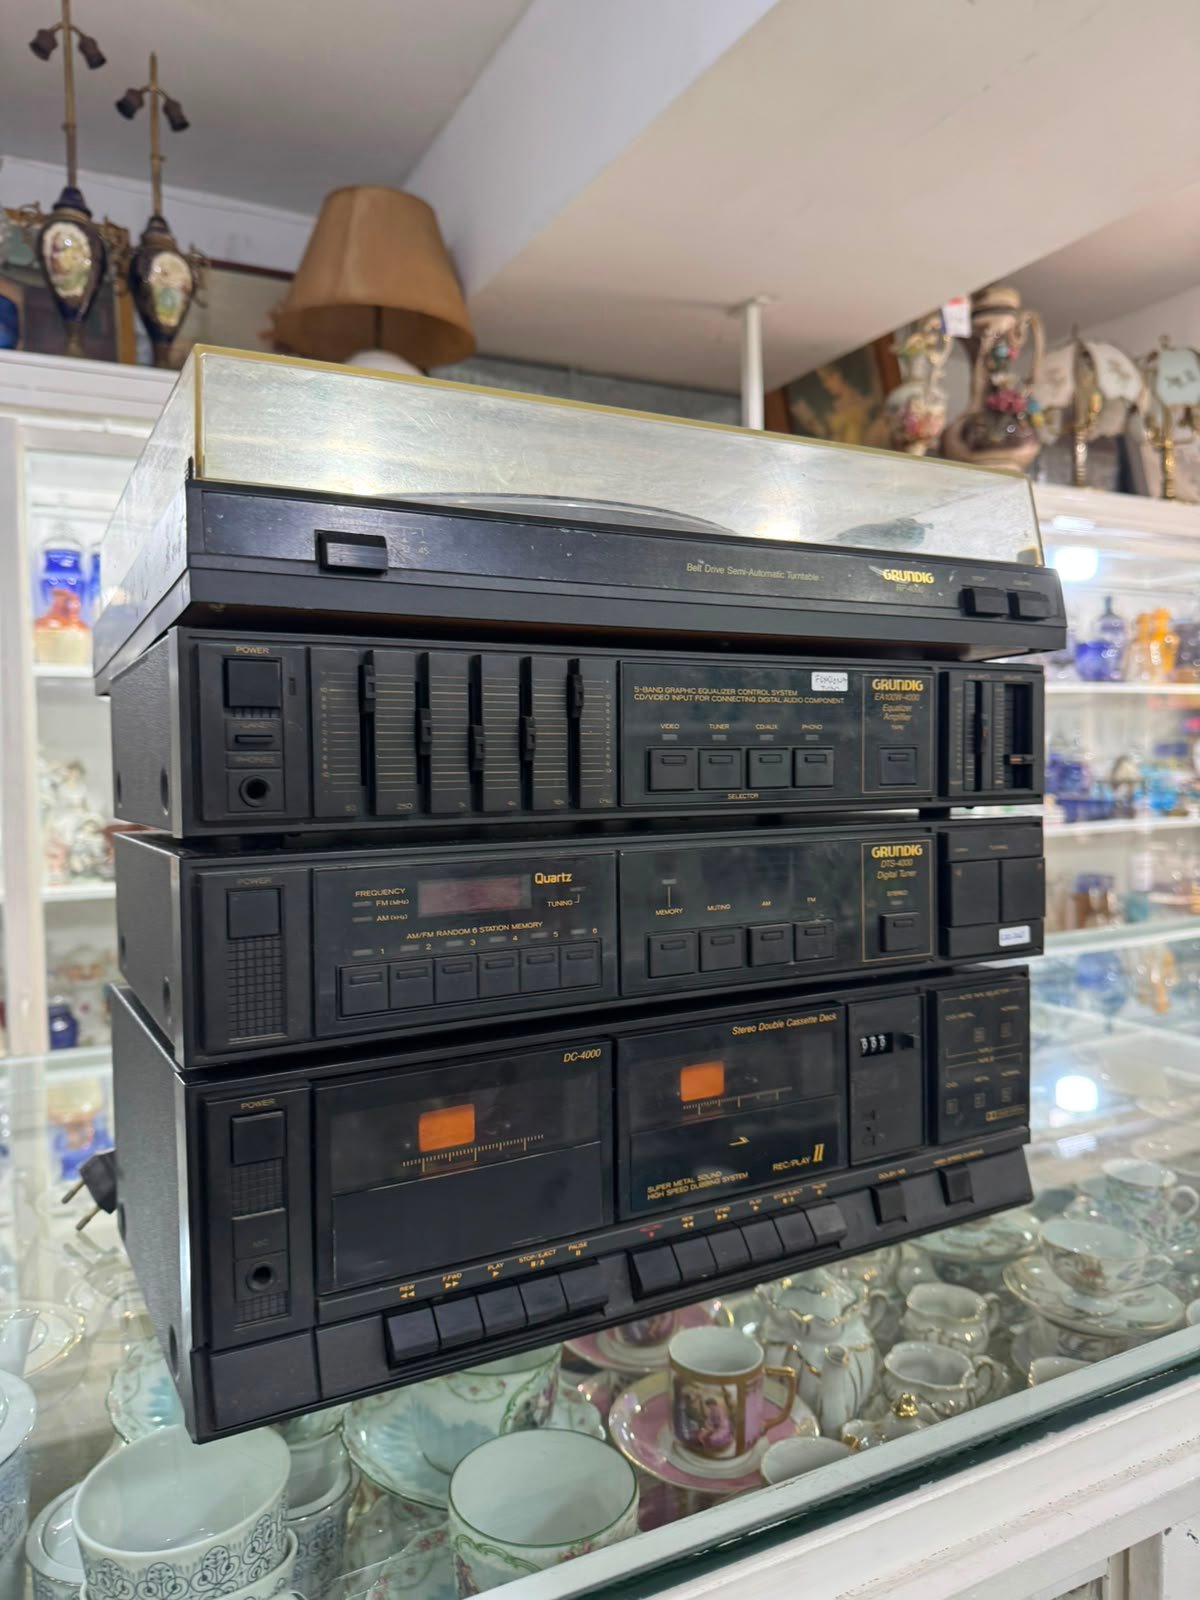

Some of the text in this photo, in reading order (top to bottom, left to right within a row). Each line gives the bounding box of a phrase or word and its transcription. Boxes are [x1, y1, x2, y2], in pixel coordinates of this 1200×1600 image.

[686, 562, 820, 582] Belt Drive Semi-Automatic Turntable
[883, 568, 935, 584] GRUNDIG
[235, 646, 270, 654] POWER
[872, 678, 924, 692] GRUNDIG
[633, 686, 798, 697] 5-BAND GRAPHIC EQUALIZER CONTROL SYSTEM
[633, 693, 670, 701] CD/VIDEO
[672, 694, 693, 702] INPUT
[758, 696, 783, 704] DIGITAL
[804, 697, 845, 705] COMPONENT
[882, 703, 913, 713] Equalizer
[727, 792, 759, 800] SELECTOR
[871, 844, 923, 859] GRUNDIG
[534, 871, 573, 885] Quartz
[876, 869, 917, 881] Digital Tuner
[237, 877, 272, 885] POWER
[355, 887, 406, 897] FREQUENCY
[376, 899, 389, 907] FM
[547, 899, 574, 908] TUNING
[707, 903, 731, 912] MUTING
[655, 907, 684, 916] MEMORY
[376, 914, 390, 923] AM
[406, 920, 544, 940] AM/FM RANDOM 6 STATION MEMORY
[731, 1012, 838, 1036] Stereo Double Cassette Deck
[563, 1048, 602, 1063] DC-4000
[240, 1098, 276, 1110] POWER
[772, 1156, 812, 1171] REC/PLAY
[646, 1170, 722, 1194] SUPER METAL SOUND
[647, 1171, 749, 1200] HIGH SPEED DUBBING SYSTEM
[568, 1241, 588, 1251] PAUSE
[487, 1262, 504, 1271] PLAY
[399, 1284, 416, 1292] REW
